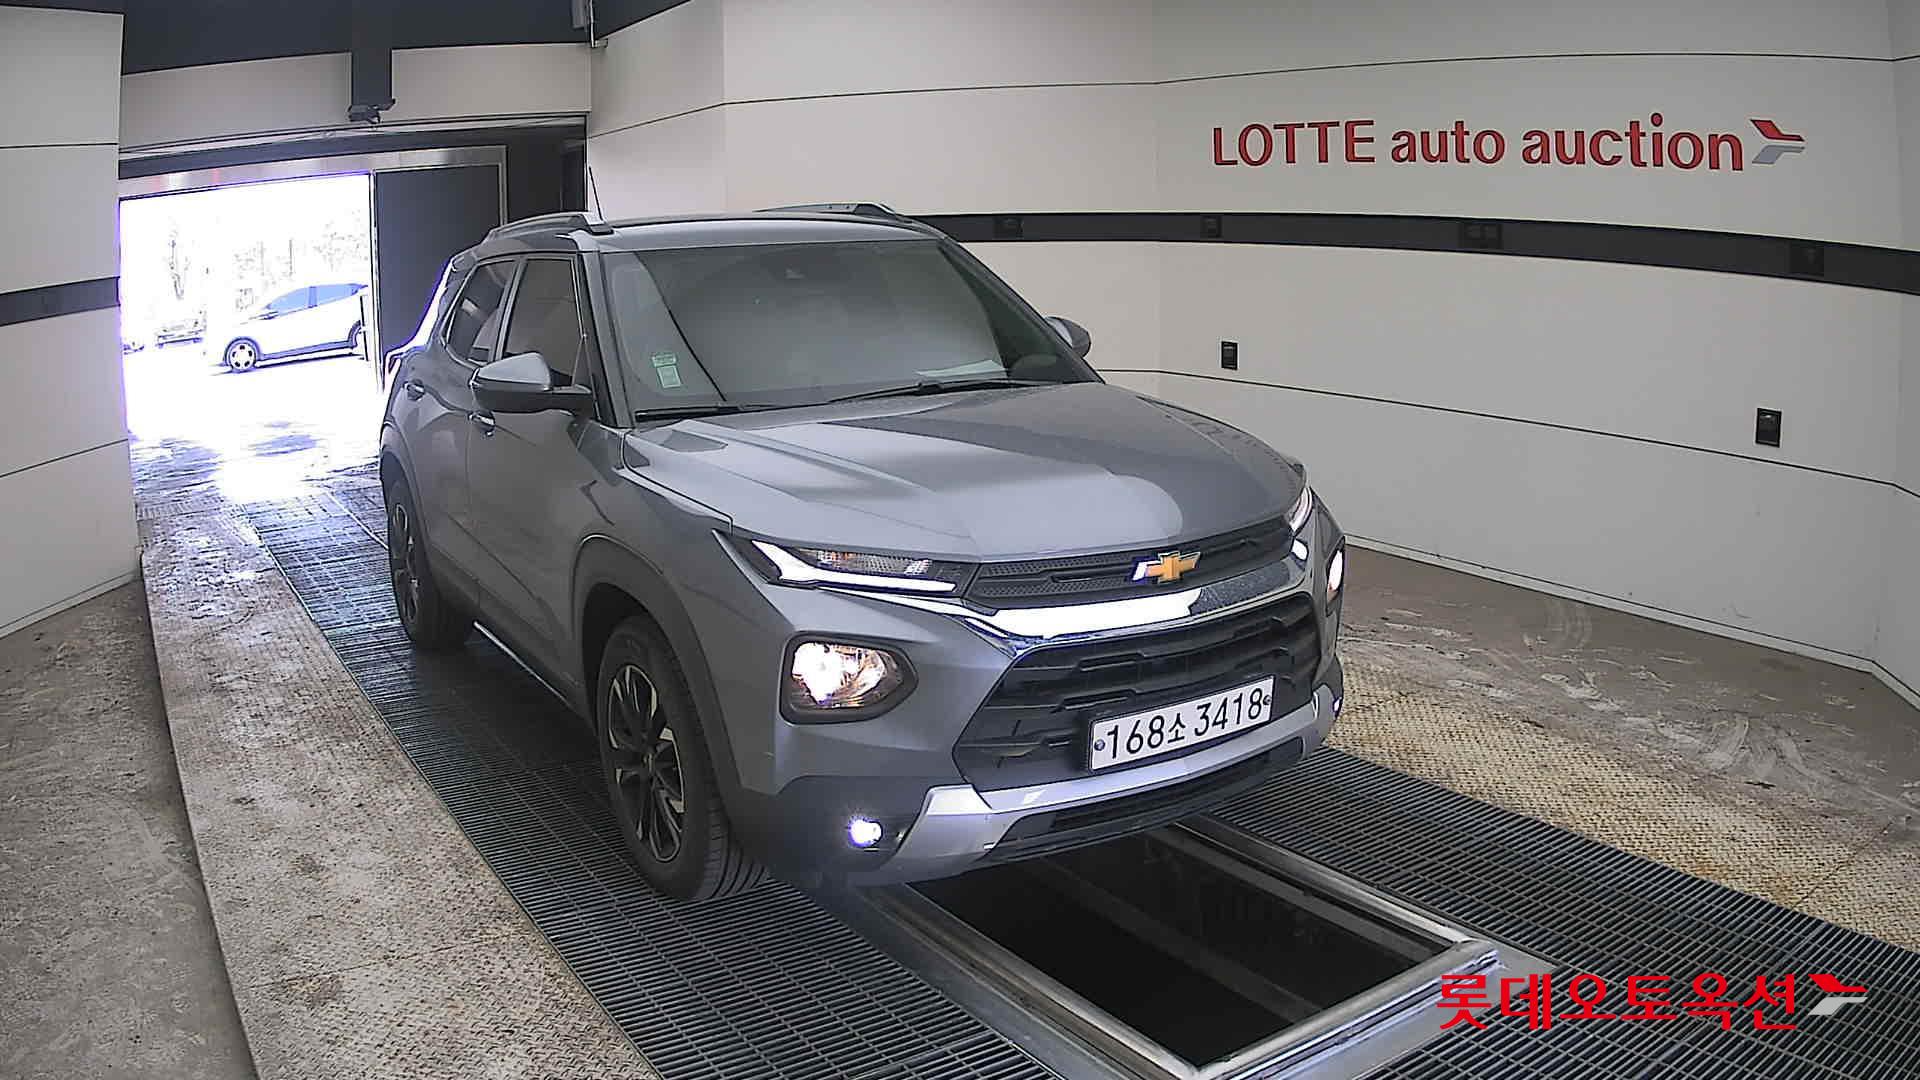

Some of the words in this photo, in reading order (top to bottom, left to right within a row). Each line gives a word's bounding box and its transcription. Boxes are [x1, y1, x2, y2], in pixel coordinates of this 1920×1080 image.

[1213, 120, 1375, 166] LOTTE
[1391, 120, 1504, 164] auto
[1521, 113, 1743, 171] auction
[1106, 712, 1186, 759] 168소
[1194, 687, 1263, 737] 3418
